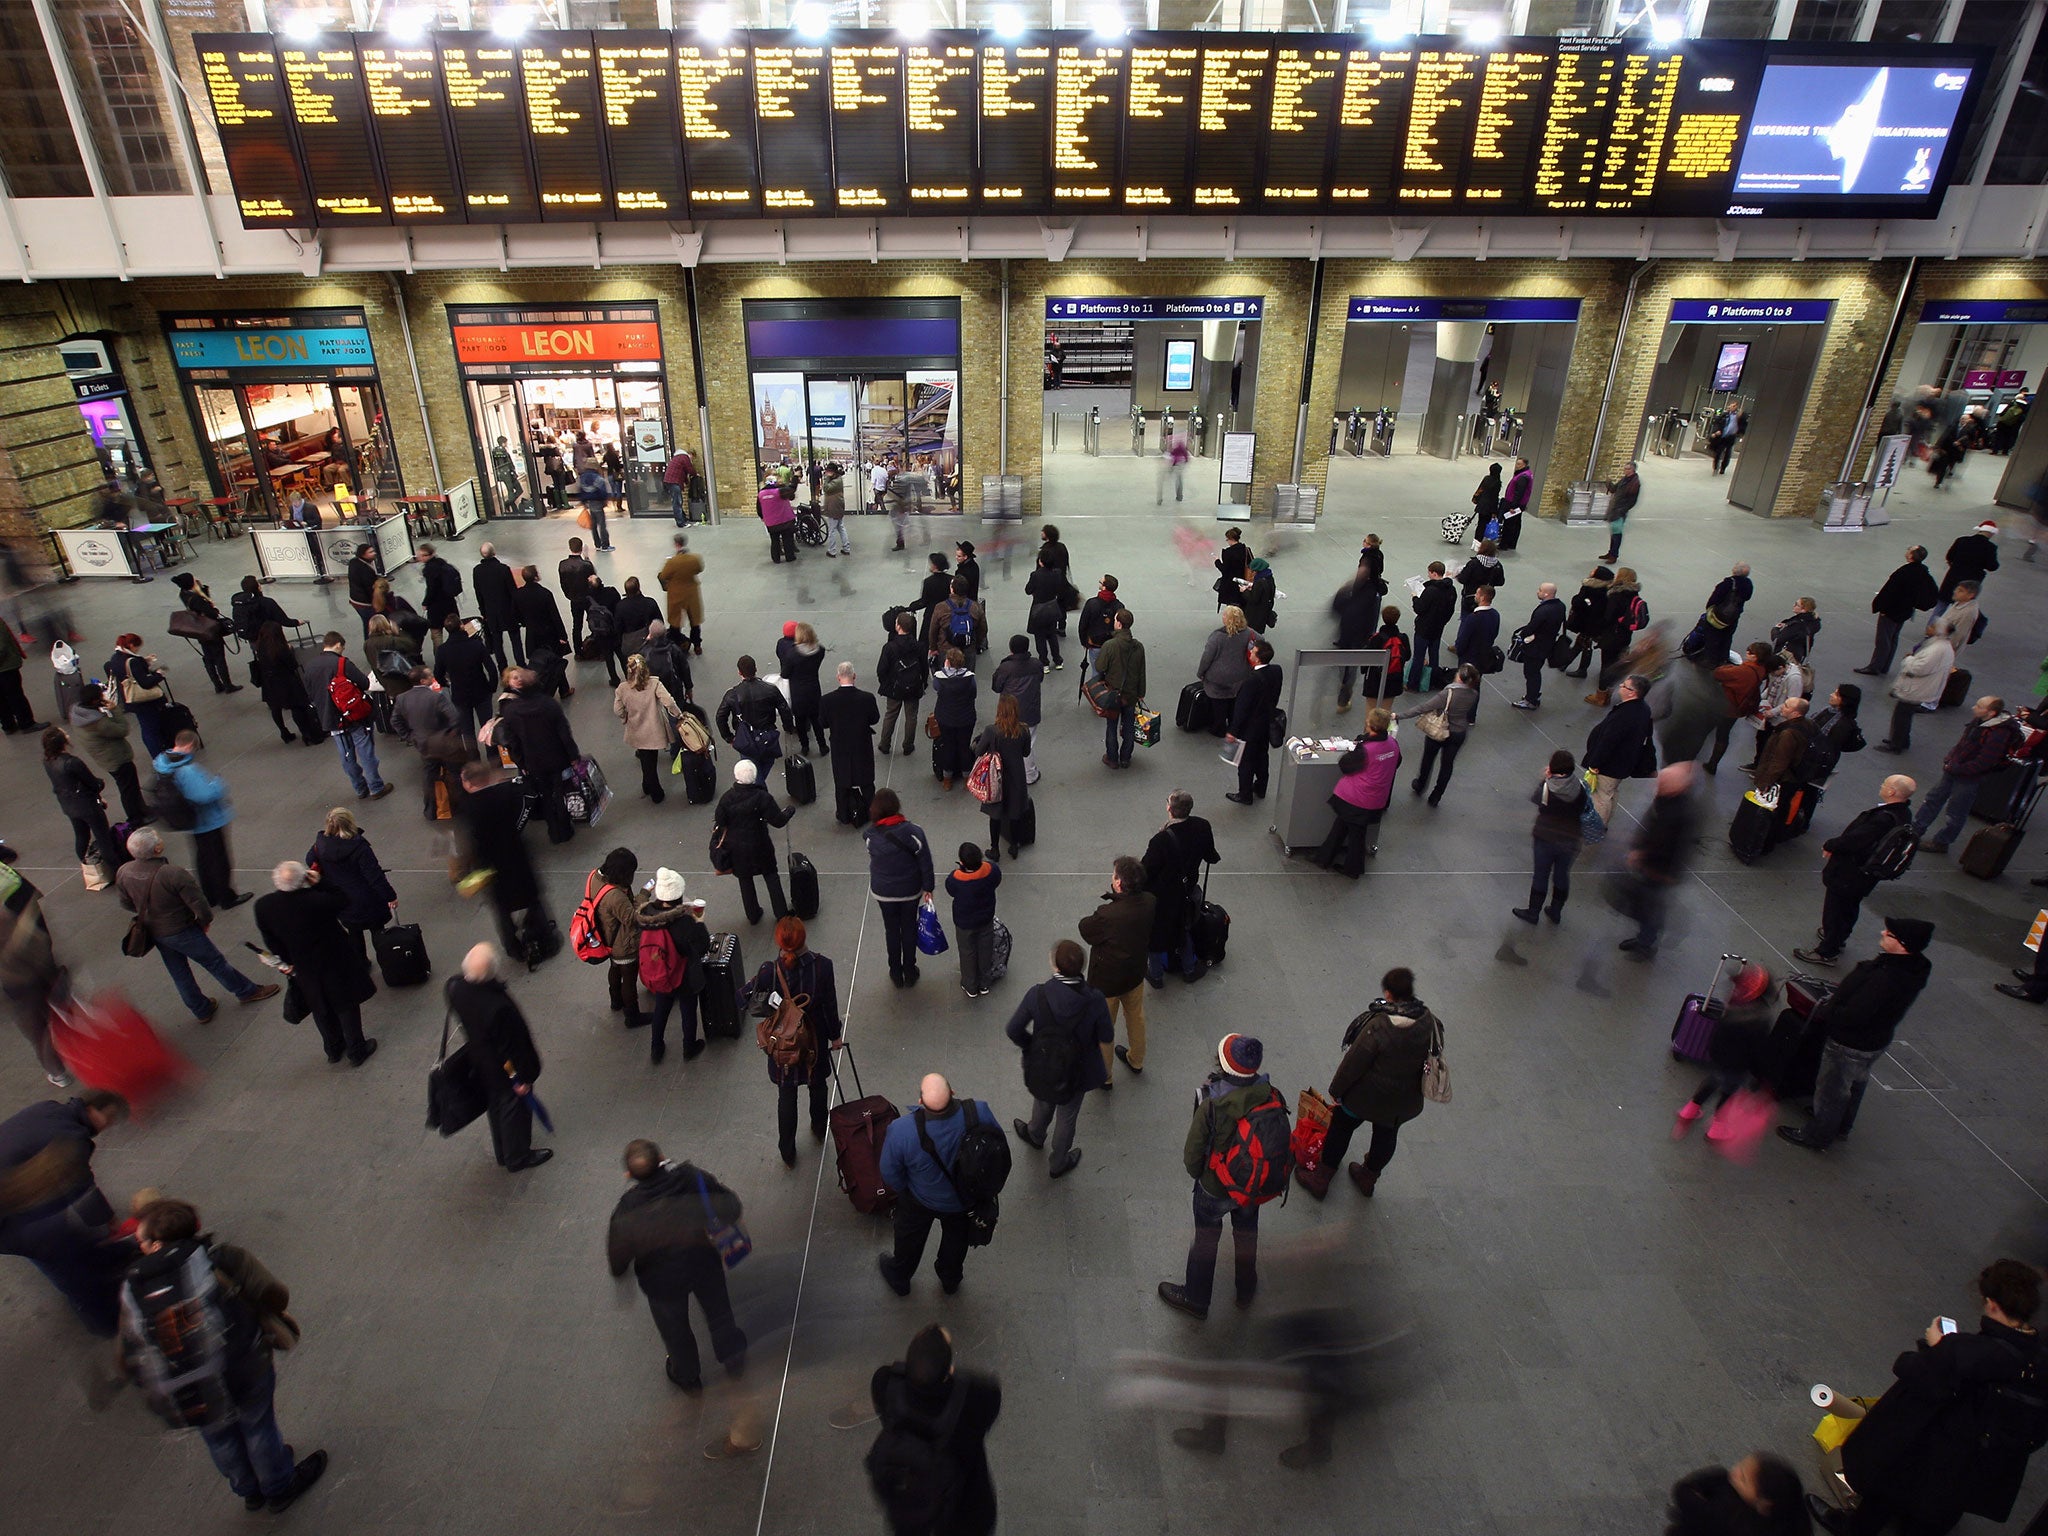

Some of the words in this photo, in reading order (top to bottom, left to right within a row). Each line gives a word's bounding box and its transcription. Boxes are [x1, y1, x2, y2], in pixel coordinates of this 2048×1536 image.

[1752, 125, 1810, 136] EXPERIENCE
[1726, 206, 1763, 215] JCDecaux
[1080, 304, 1120, 313] Platforms
[1124, 304, 1129, 312] 9
[1166, 304, 1204, 312] Platforms
[1206, 304, 1211, 312] 0
[1224, 304, 1230, 312] 8
[1722, 307, 1764, 317] Platforms
[1766, 307, 1772, 316] 0
[1774, 308, 1783, 316] to
[1785, 307, 1792, 316] 8
[521, 329, 594, 356] LEON
[234, 335, 309, 361] LEON
[89, 384, 109, 392] Tickets
[266, 546, 308, 561] LEON
